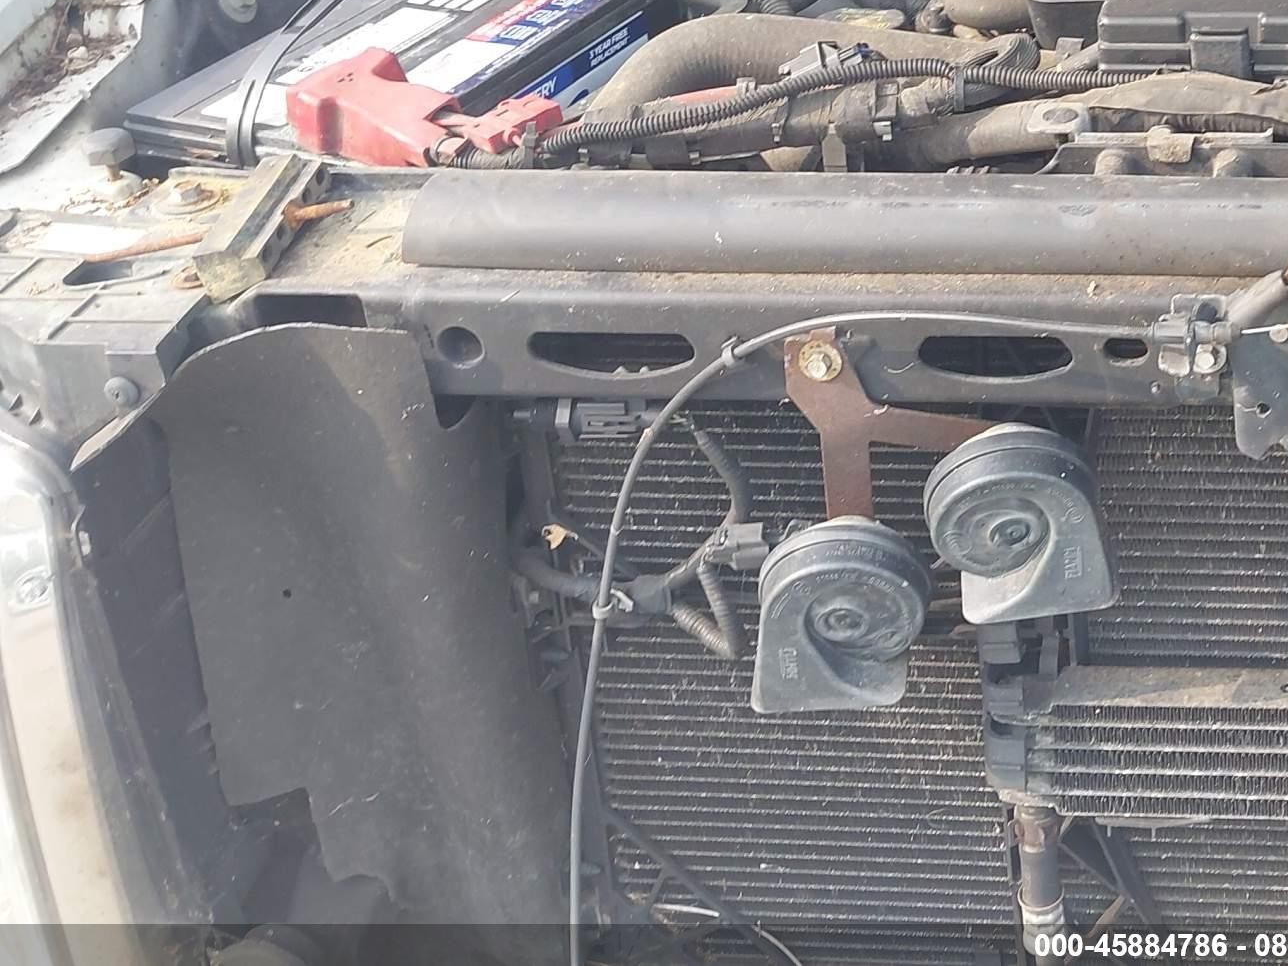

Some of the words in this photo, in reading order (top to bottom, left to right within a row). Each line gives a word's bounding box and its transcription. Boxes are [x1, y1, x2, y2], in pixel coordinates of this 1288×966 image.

[590, 36, 629, 68] REPLACEMENT
[594, 38, 612, 56] YEAR
[611, 27, 629, 45] FREE
